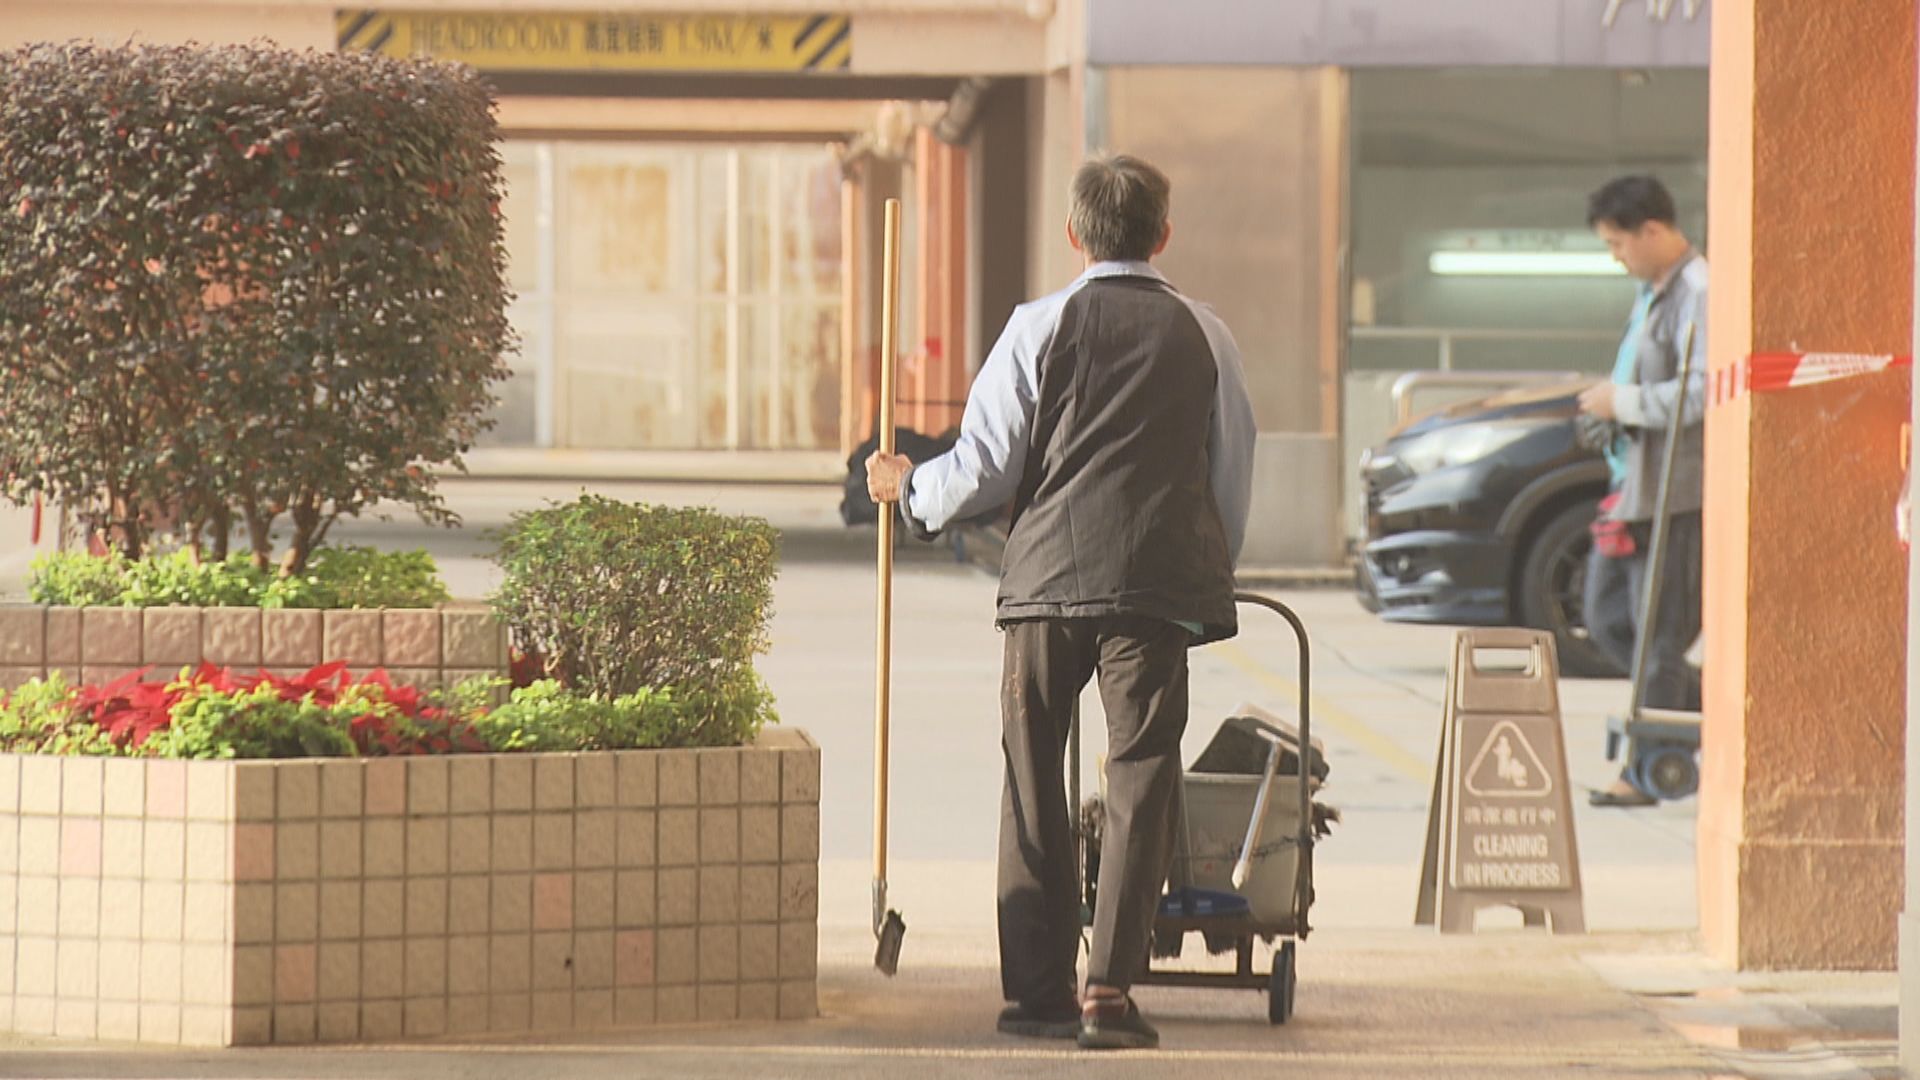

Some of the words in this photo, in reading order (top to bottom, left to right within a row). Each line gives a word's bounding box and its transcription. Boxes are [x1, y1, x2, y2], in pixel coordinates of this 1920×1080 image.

[410, 16, 570, 53] HEADROOM
[1473, 833, 1548, 858] CLEANING
[1463, 863, 1481, 886] IN
[1482, 863, 1560, 887] PROGRESS
